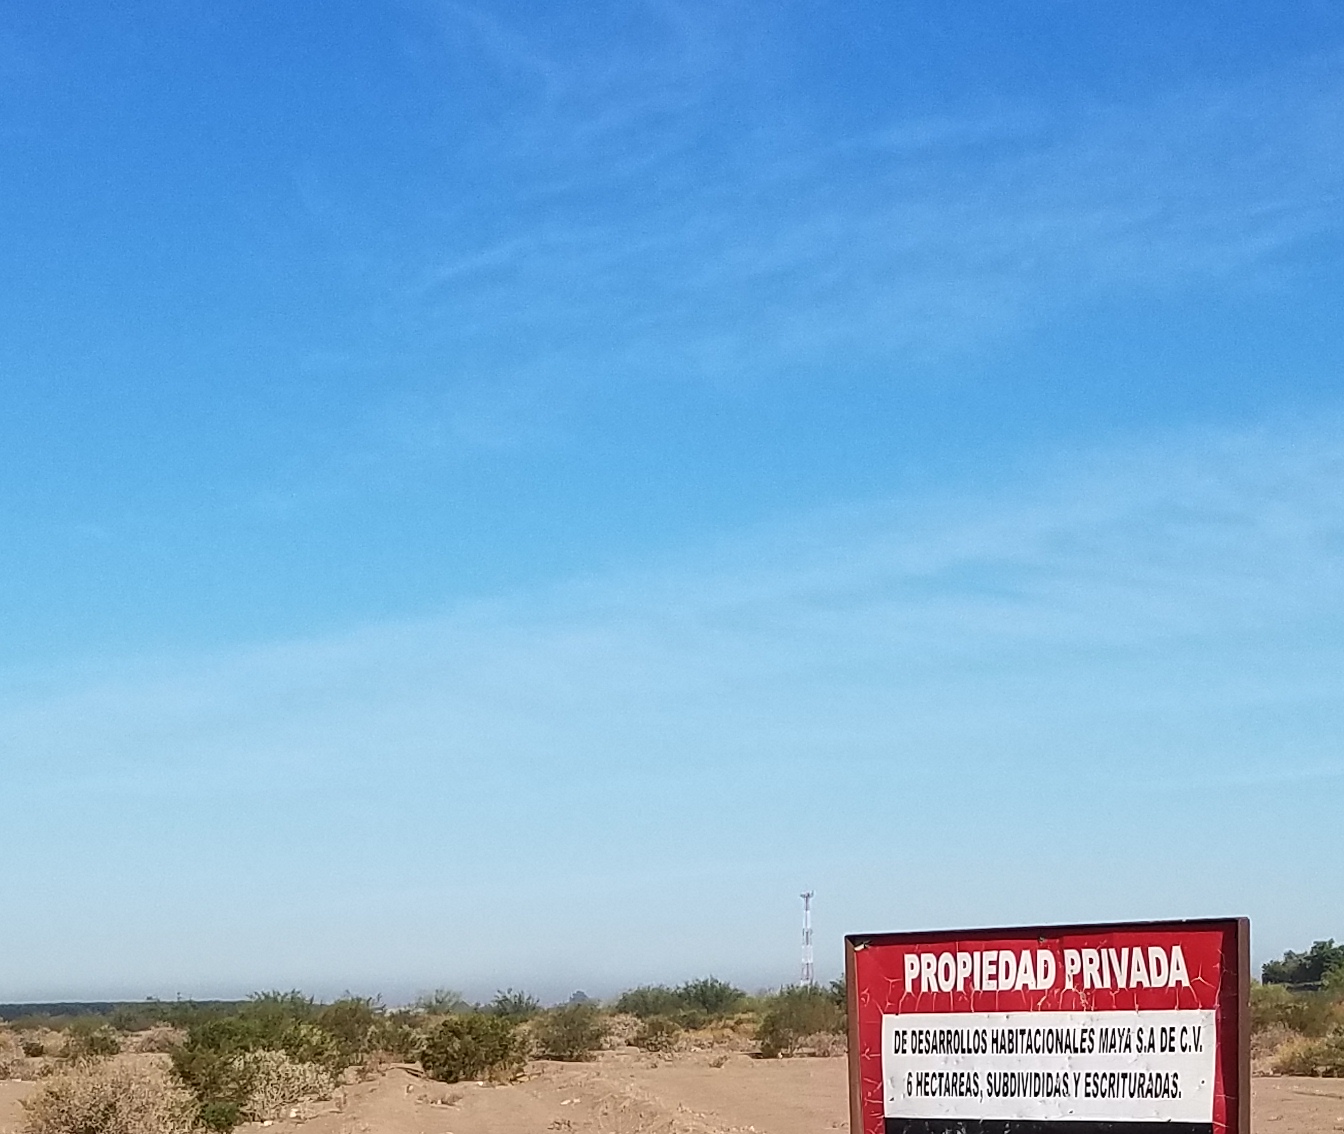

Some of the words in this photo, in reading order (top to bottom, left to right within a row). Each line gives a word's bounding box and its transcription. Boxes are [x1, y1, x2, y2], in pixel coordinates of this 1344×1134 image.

[904, 950, 1056, 992] PROPIEDAD
[1064, 946, 1190, 989] PRIVADA
[894, 1030, 907, 1054] DE
[911, 1029, 987, 1054] DESARROLLOS
[991, 1028, 1095, 1054] HABITACIONALES
[1098, 1028, 1132, 1053] MAYA
[1135, 1027, 1155, 1053] S.A
[1160, 1027, 1176, 1053] DE
[1180, 1026, 1203, 1053] C.V.
[906, 1072, 913, 1096] 6
[916, 1072, 984, 1103] HECTAREAS,
[986, 1072, 1070, 1097] SUBDIVIDIDAS
[1073, 1072, 1081, 1097] Y
[1084, 1072, 1182, 1098] ESCRITURADAS.
